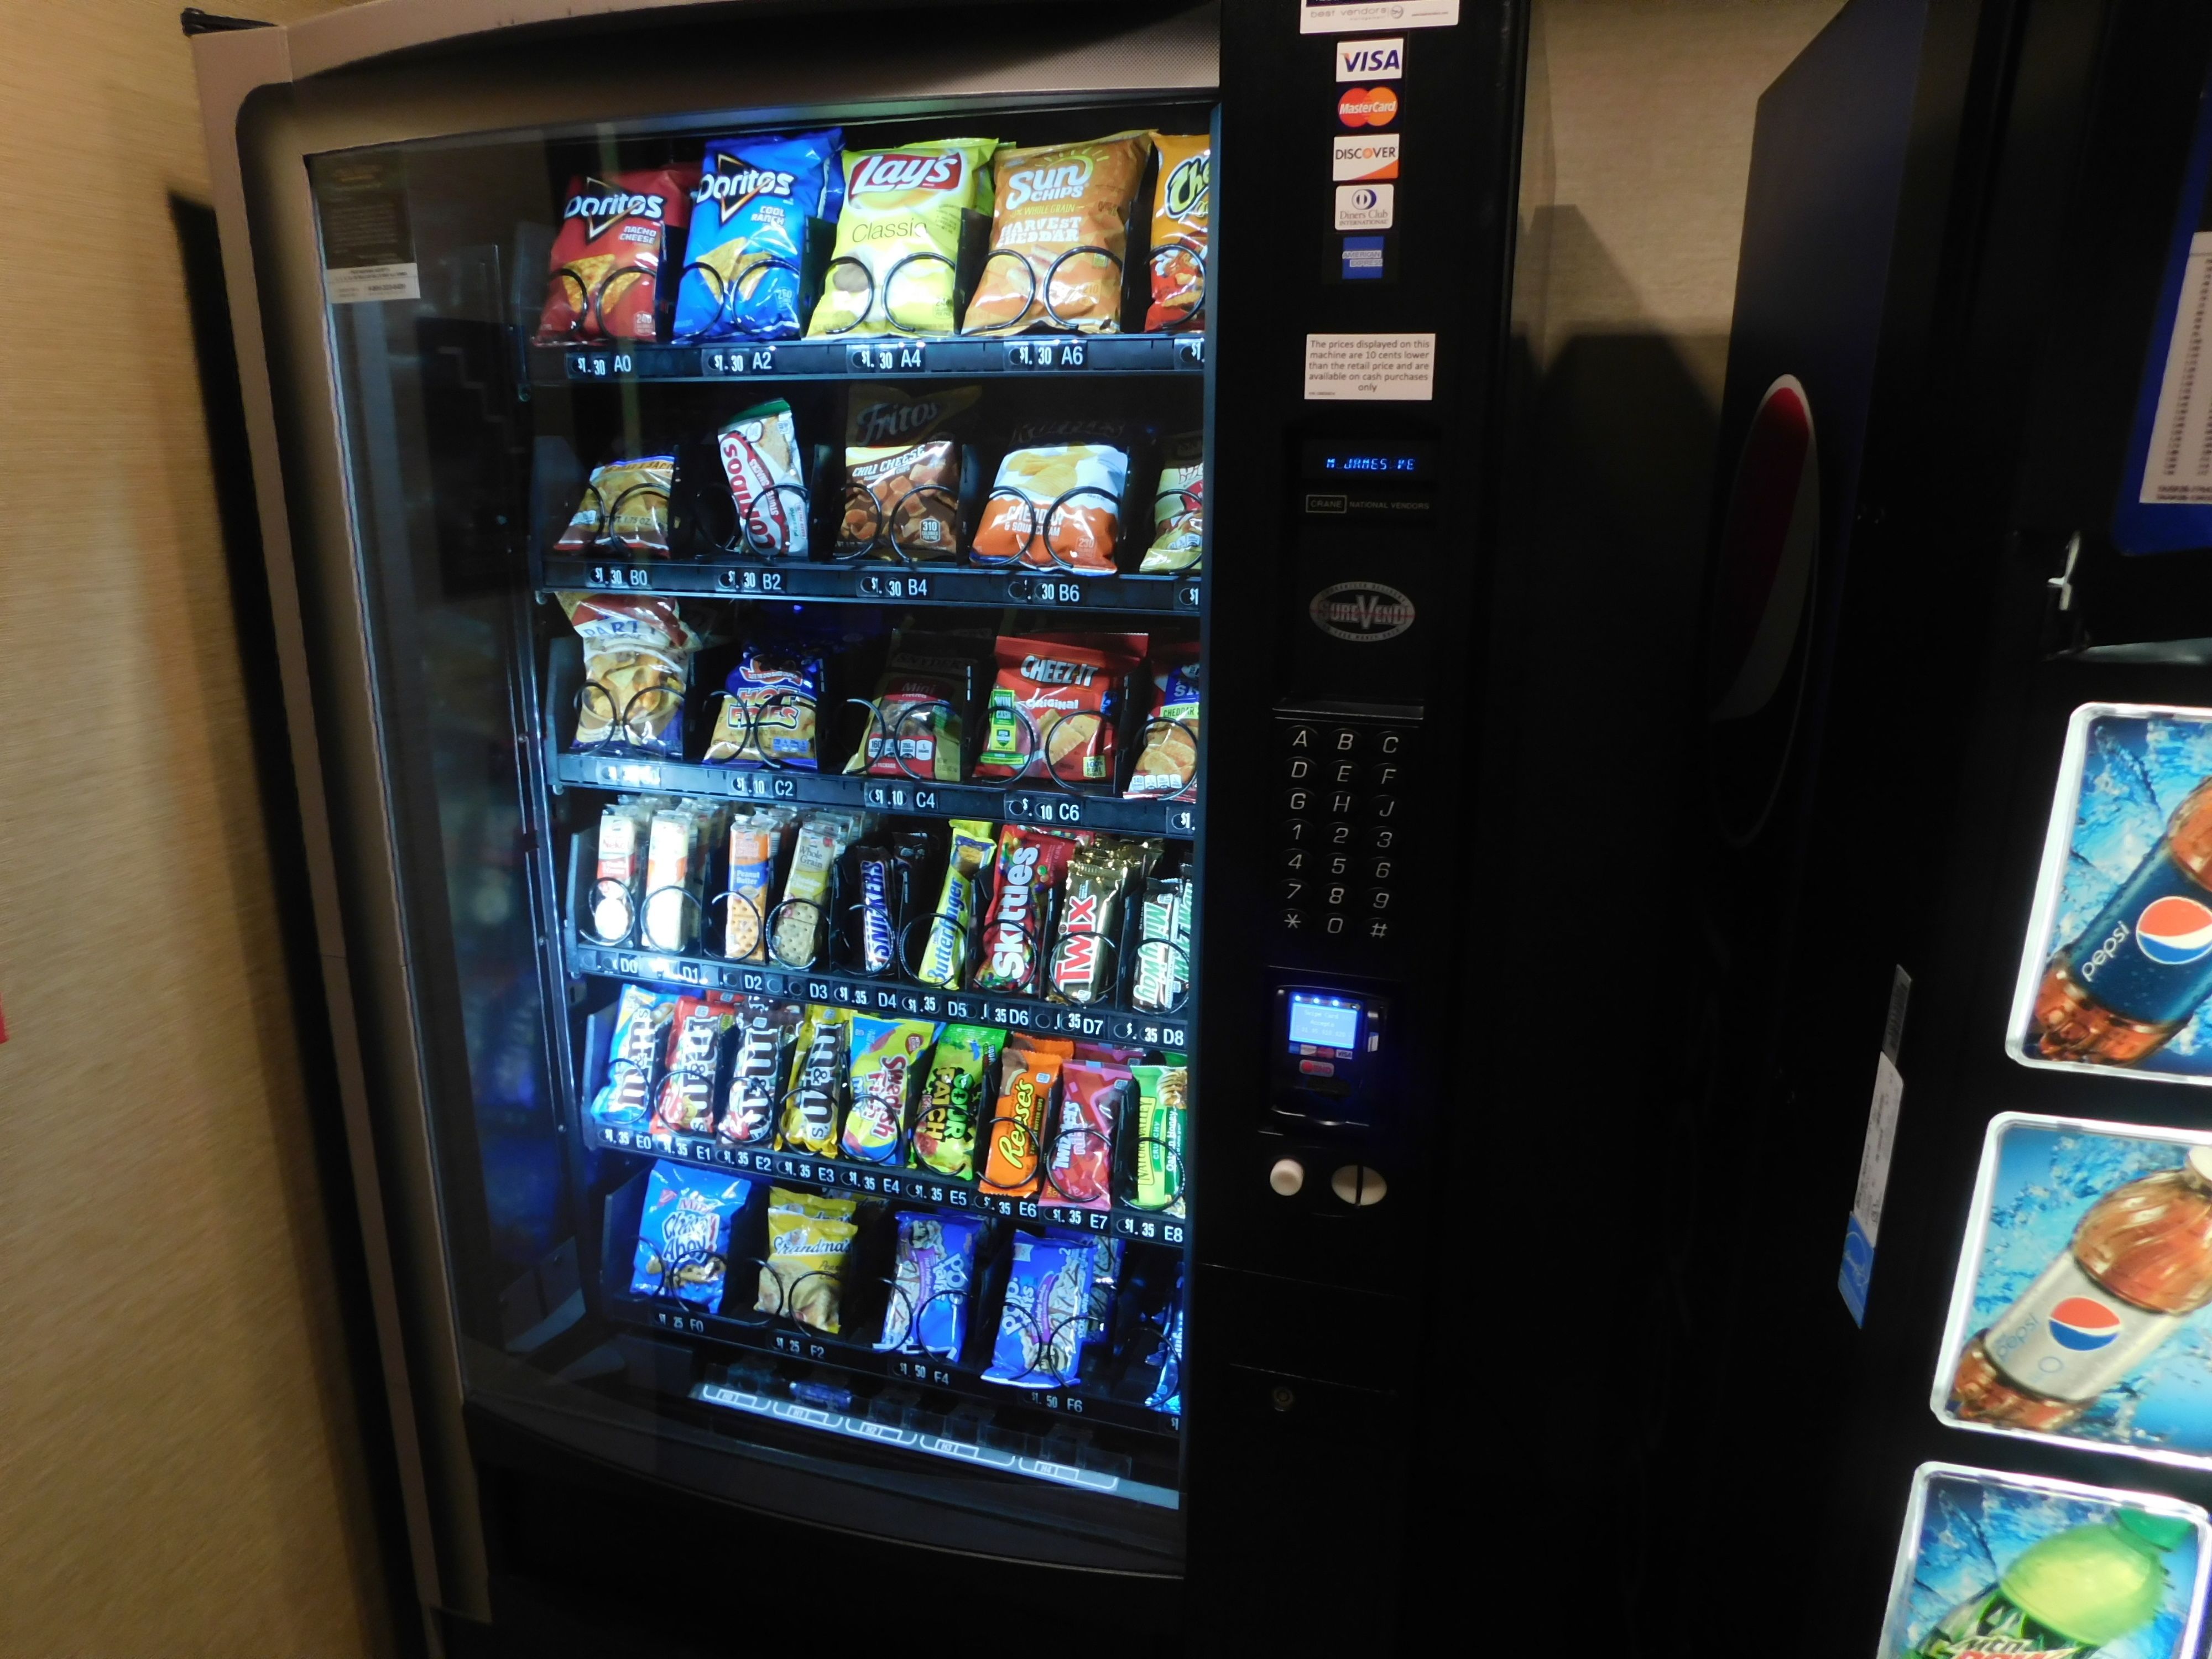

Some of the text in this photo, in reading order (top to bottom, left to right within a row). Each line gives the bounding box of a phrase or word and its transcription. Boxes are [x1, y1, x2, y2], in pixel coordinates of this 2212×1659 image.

[1340, 7, 1387, 17] vendors
[1343, 49, 1400, 73] VISA
[1339, 100, 1397, 115] MasterCard
[1335, 147, 1397, 161] DISCOVER
[852, 153, 958, 192] Lay's
[696, 169, 795, 204] Doritos
[1005, 166, 1093, 210] Sun
[1030, 185, 1084, 202] CHIPS
[563, 192, 664, 220] Doritos
[759, 205, 785, 216] COOL
[1051, 204, 1076, 214] GRAIN
[751, 213, 785, 225] RANCH
[1340, 209, 1388, 220] Diners Club
[624, 226, 657, 237] NACHO
[852, 219, 927, 243] Classic
[1000, 216, 1082, 236] HARVEST
[619, 233, 655, 244] CHEESE
[996, 228, 1079, 248] CHEDDAR
[1343, 251, 1381, 259] AMERICAN
[1311, 340, 1326, 348] The
[1328, 341, 1354, 350] prices
[1356, 340, 1397, 350] displayed
[1413, 340, 1430, 348] this
[753, 352, 772, 369] A2
[901, 348, 922, 367] A4
[1061, 346, 1083, 365] A6
[1310, 351, 1347, 359] machine
[1366, 351, 1376, 359] 10
[1378, 351, 1402, 359] cents
[1404, 351, 1430, 359] lower
[614, 356, 632, 372] A0
[1309, 361, 1328, 369] than
[1331, 361, 1345, 369] the
[1347, 361, 1370, 370] retail
[1372, 362, 1394, 372] price
[1396, 361, 1412, 370] and
[1308, 372, 1346, 381] available
[1363, 372, 1382, 381] cash
[1384, 373, 1428, 383] purchases
[1358, 383, 1378, 393] only
[857, 402, 940, 444] Fritos
[852, 463, 878, 477] CHILI
[879, 444, 926, 472] CHEESE
[1344, 458, 1387, 470] JAMES
[1310, 499, 1343, 509] CRANE
[1390, 501, 1430, 510] VENDORS
[922, 521, 937, 531] 310
[763, 573, 781, 589] B2
[908, 578, 927, 596] B4
[1059, 583, 1079, 602] B6
[1163, 706, 1194, 718] CHEDDAR
[1292, 730, 1399, 754] A B C
[1291, 761, 1397, 784] D E F
[775, 779, 794, 796] C2
[916, 791, 936, 810] C4
[1290, 793, 1395, 817] G H J
[1059, 802, 1079, 821] C6
[1292, 824, 1392, 848] 1 2 3
[799, 846, 823, 859] Whole
[800, 858, 823, 869] Grain
[1288, 854, 1391, 878] 4 5 6
[737, 869, 760, 879] Peanut
[1287, 883, 1389, 909] 7 8 9
[992, 847, 1039, 980] Skittles
[927, 877, 964, 981] Butterfinger
[1370, 922, 1387, 938] #
[2081, 920, 2131, 982] pepsi
[744, 974, 763, 990] D2
[810, 983, 828, 999] D3
[878, 992, 897, 1008] D4
[948, 1001, 967, 1018] D5
[1009, 1009, 1029, 1026] D6
[1083, 1018, 1103, 1035] D7
[1164, 1029, 1184, 1046] D8
[998, 1078, 1035, 1169] Reese's
[696, 1146, 711, 1161] E1
[755, 1156, 772, 1172] E2
[818, 1167, 834, 1182] E3
[883, 1178, 900, 1194] E4
[950, 1190, 967, 1206] E5
[1019, 1202, 1037, 1218] E6
[1090, 1214, 1108, 1230] E7
[1164, 1227, 1183, 1243] E8
[773, 1237, 851, 1255] Grandma's
[810, 1344, 825, 1359] F2
[934, 1371, 950, 1386] F4
[1067, 1400, 1083, 1413] F6
[865, 1425, 878, 1435] H2
[941, 1442, 952, 1452] H3
[1040, 1464, 1051, 1474] H4
